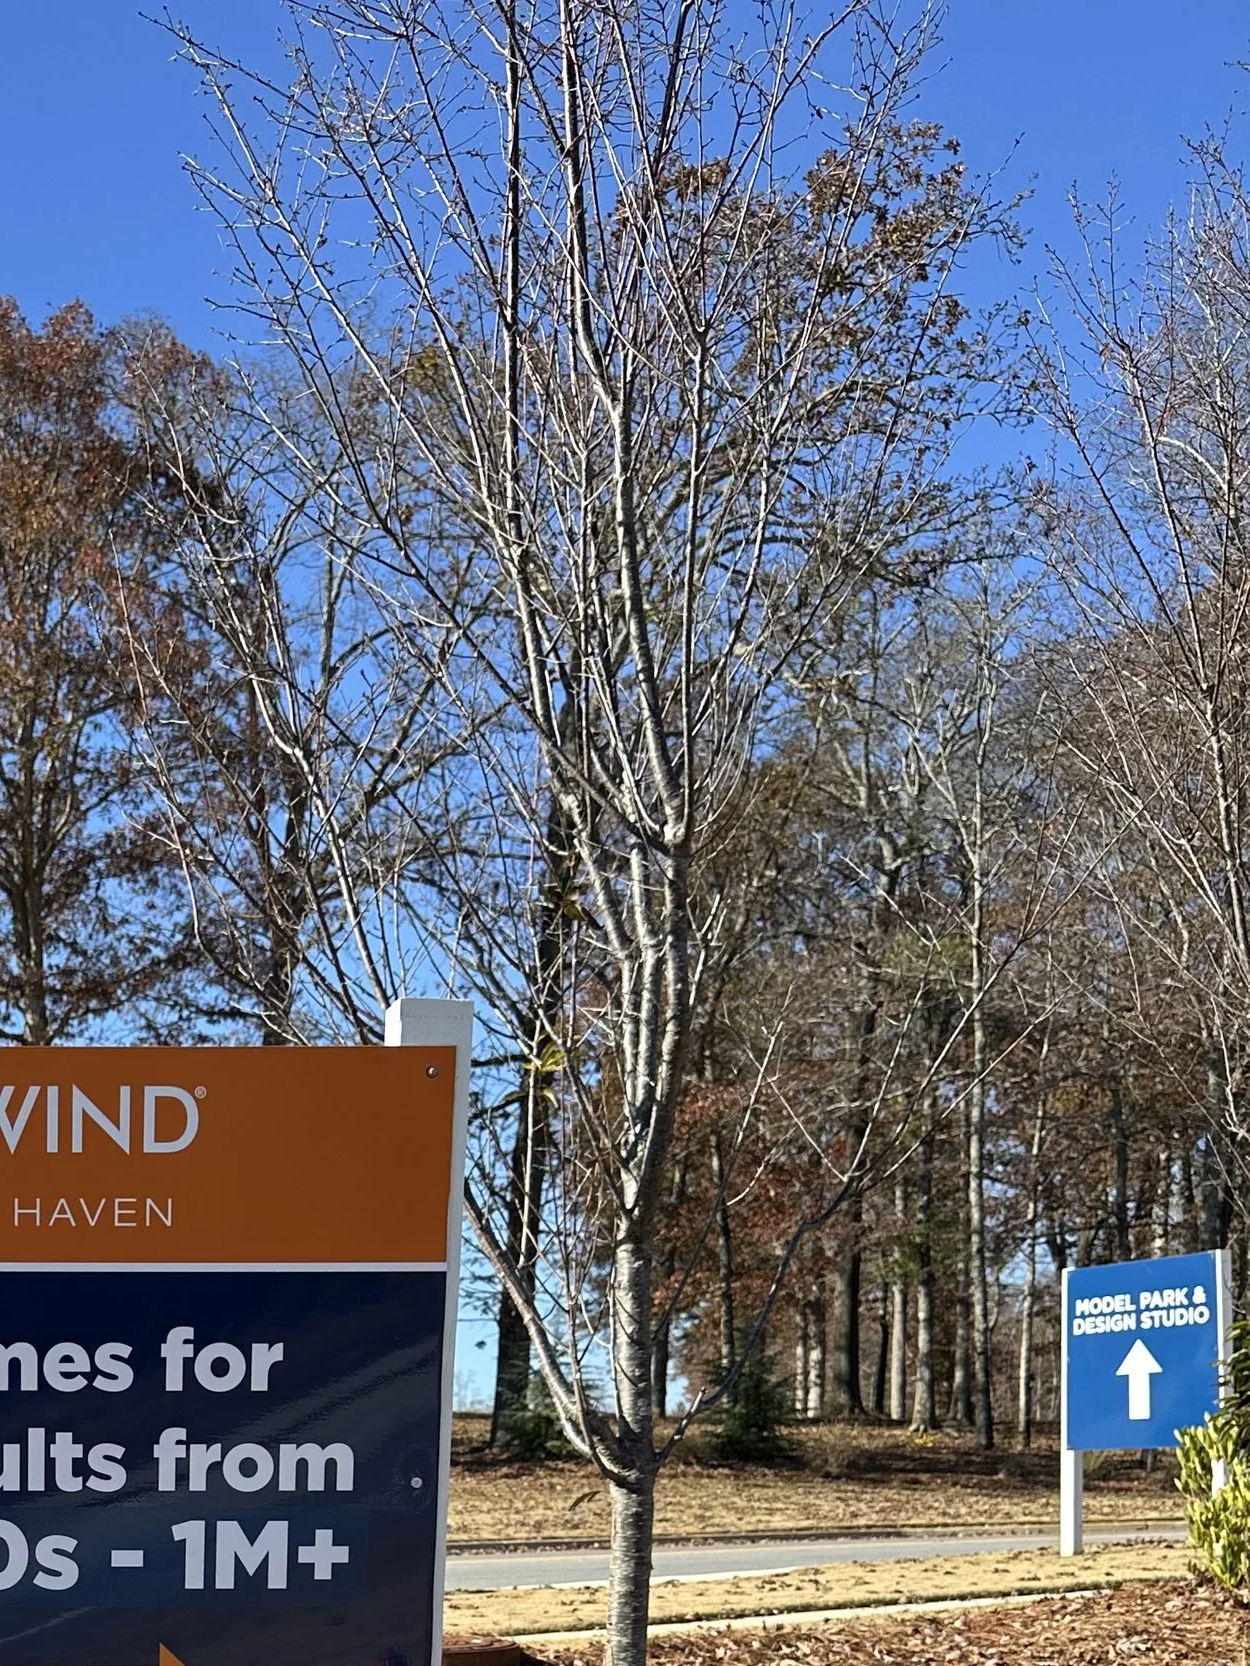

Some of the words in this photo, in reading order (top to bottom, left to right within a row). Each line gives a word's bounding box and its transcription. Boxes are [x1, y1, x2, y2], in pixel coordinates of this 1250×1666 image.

[14, 1197, 173, 1227] HAVEN
[1072, 1313, 1137, 1336] DESIGN
[1140, 1305, 1210, 1329] STUDIO
[1075, 1294, 1136, 1316] MODEL
[1139, 1287, 1189, 1310] PARK
[1192, 1285, 1207, 1305] &
[160, 1326, 284, 1393] for
[153, 1427, 356, 1493] from
[110, 1549, 144, 1568] -
[170, 1520, 350, 1590] 1M+
